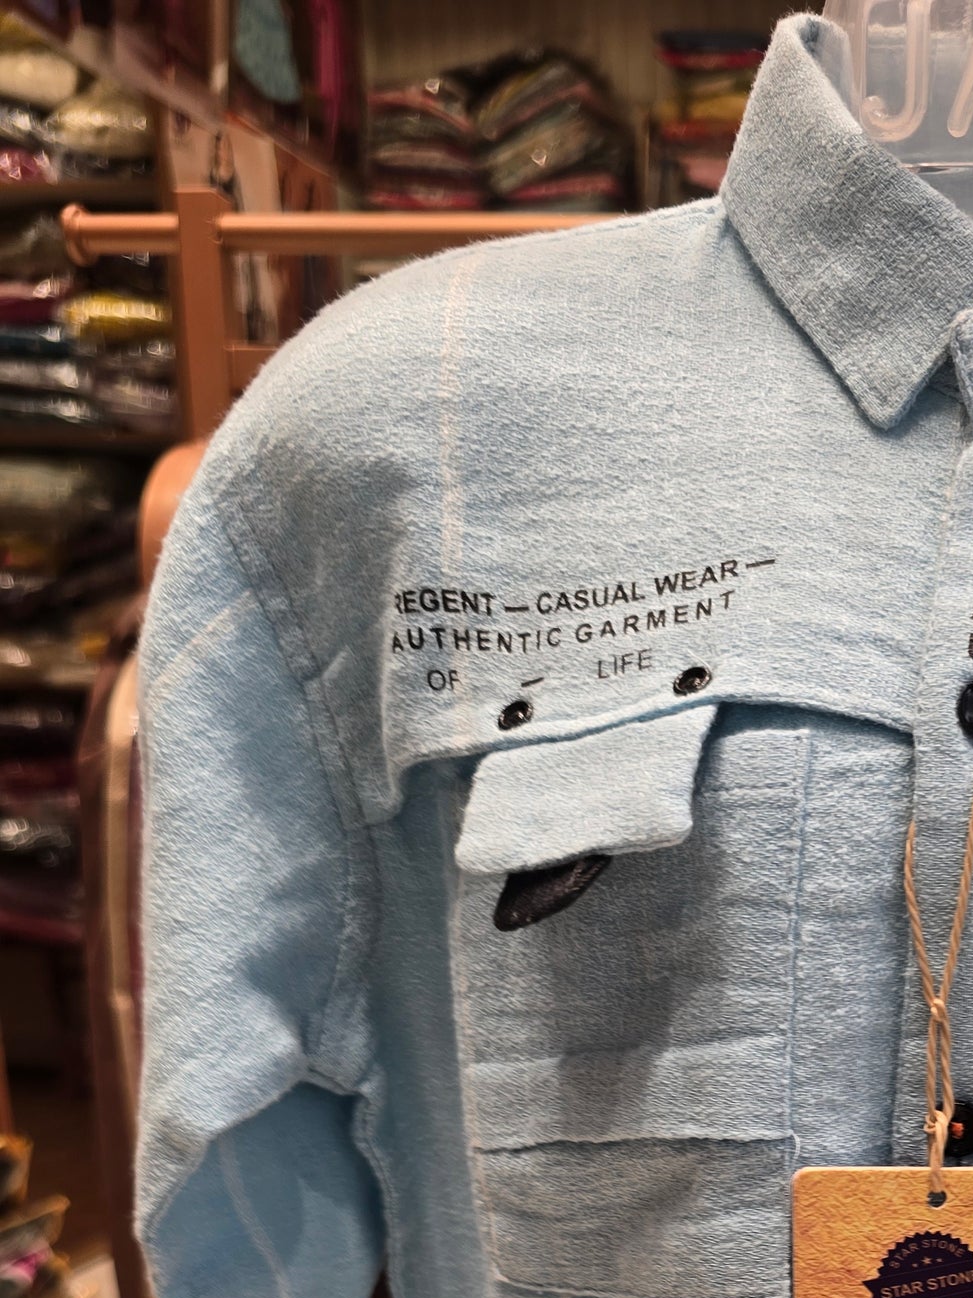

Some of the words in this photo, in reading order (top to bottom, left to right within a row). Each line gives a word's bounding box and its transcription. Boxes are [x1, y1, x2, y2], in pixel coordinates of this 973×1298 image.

[536, 581, 646, 615] CASUAL
[653, 559, 739, 596] WEAR
[392, 626, 562, 654] AUTHENTIC
[575, 590, 735, 644] GARMENT
[427, 669, 461, 692] OF
[598, 649, 652, 679] LIFE
